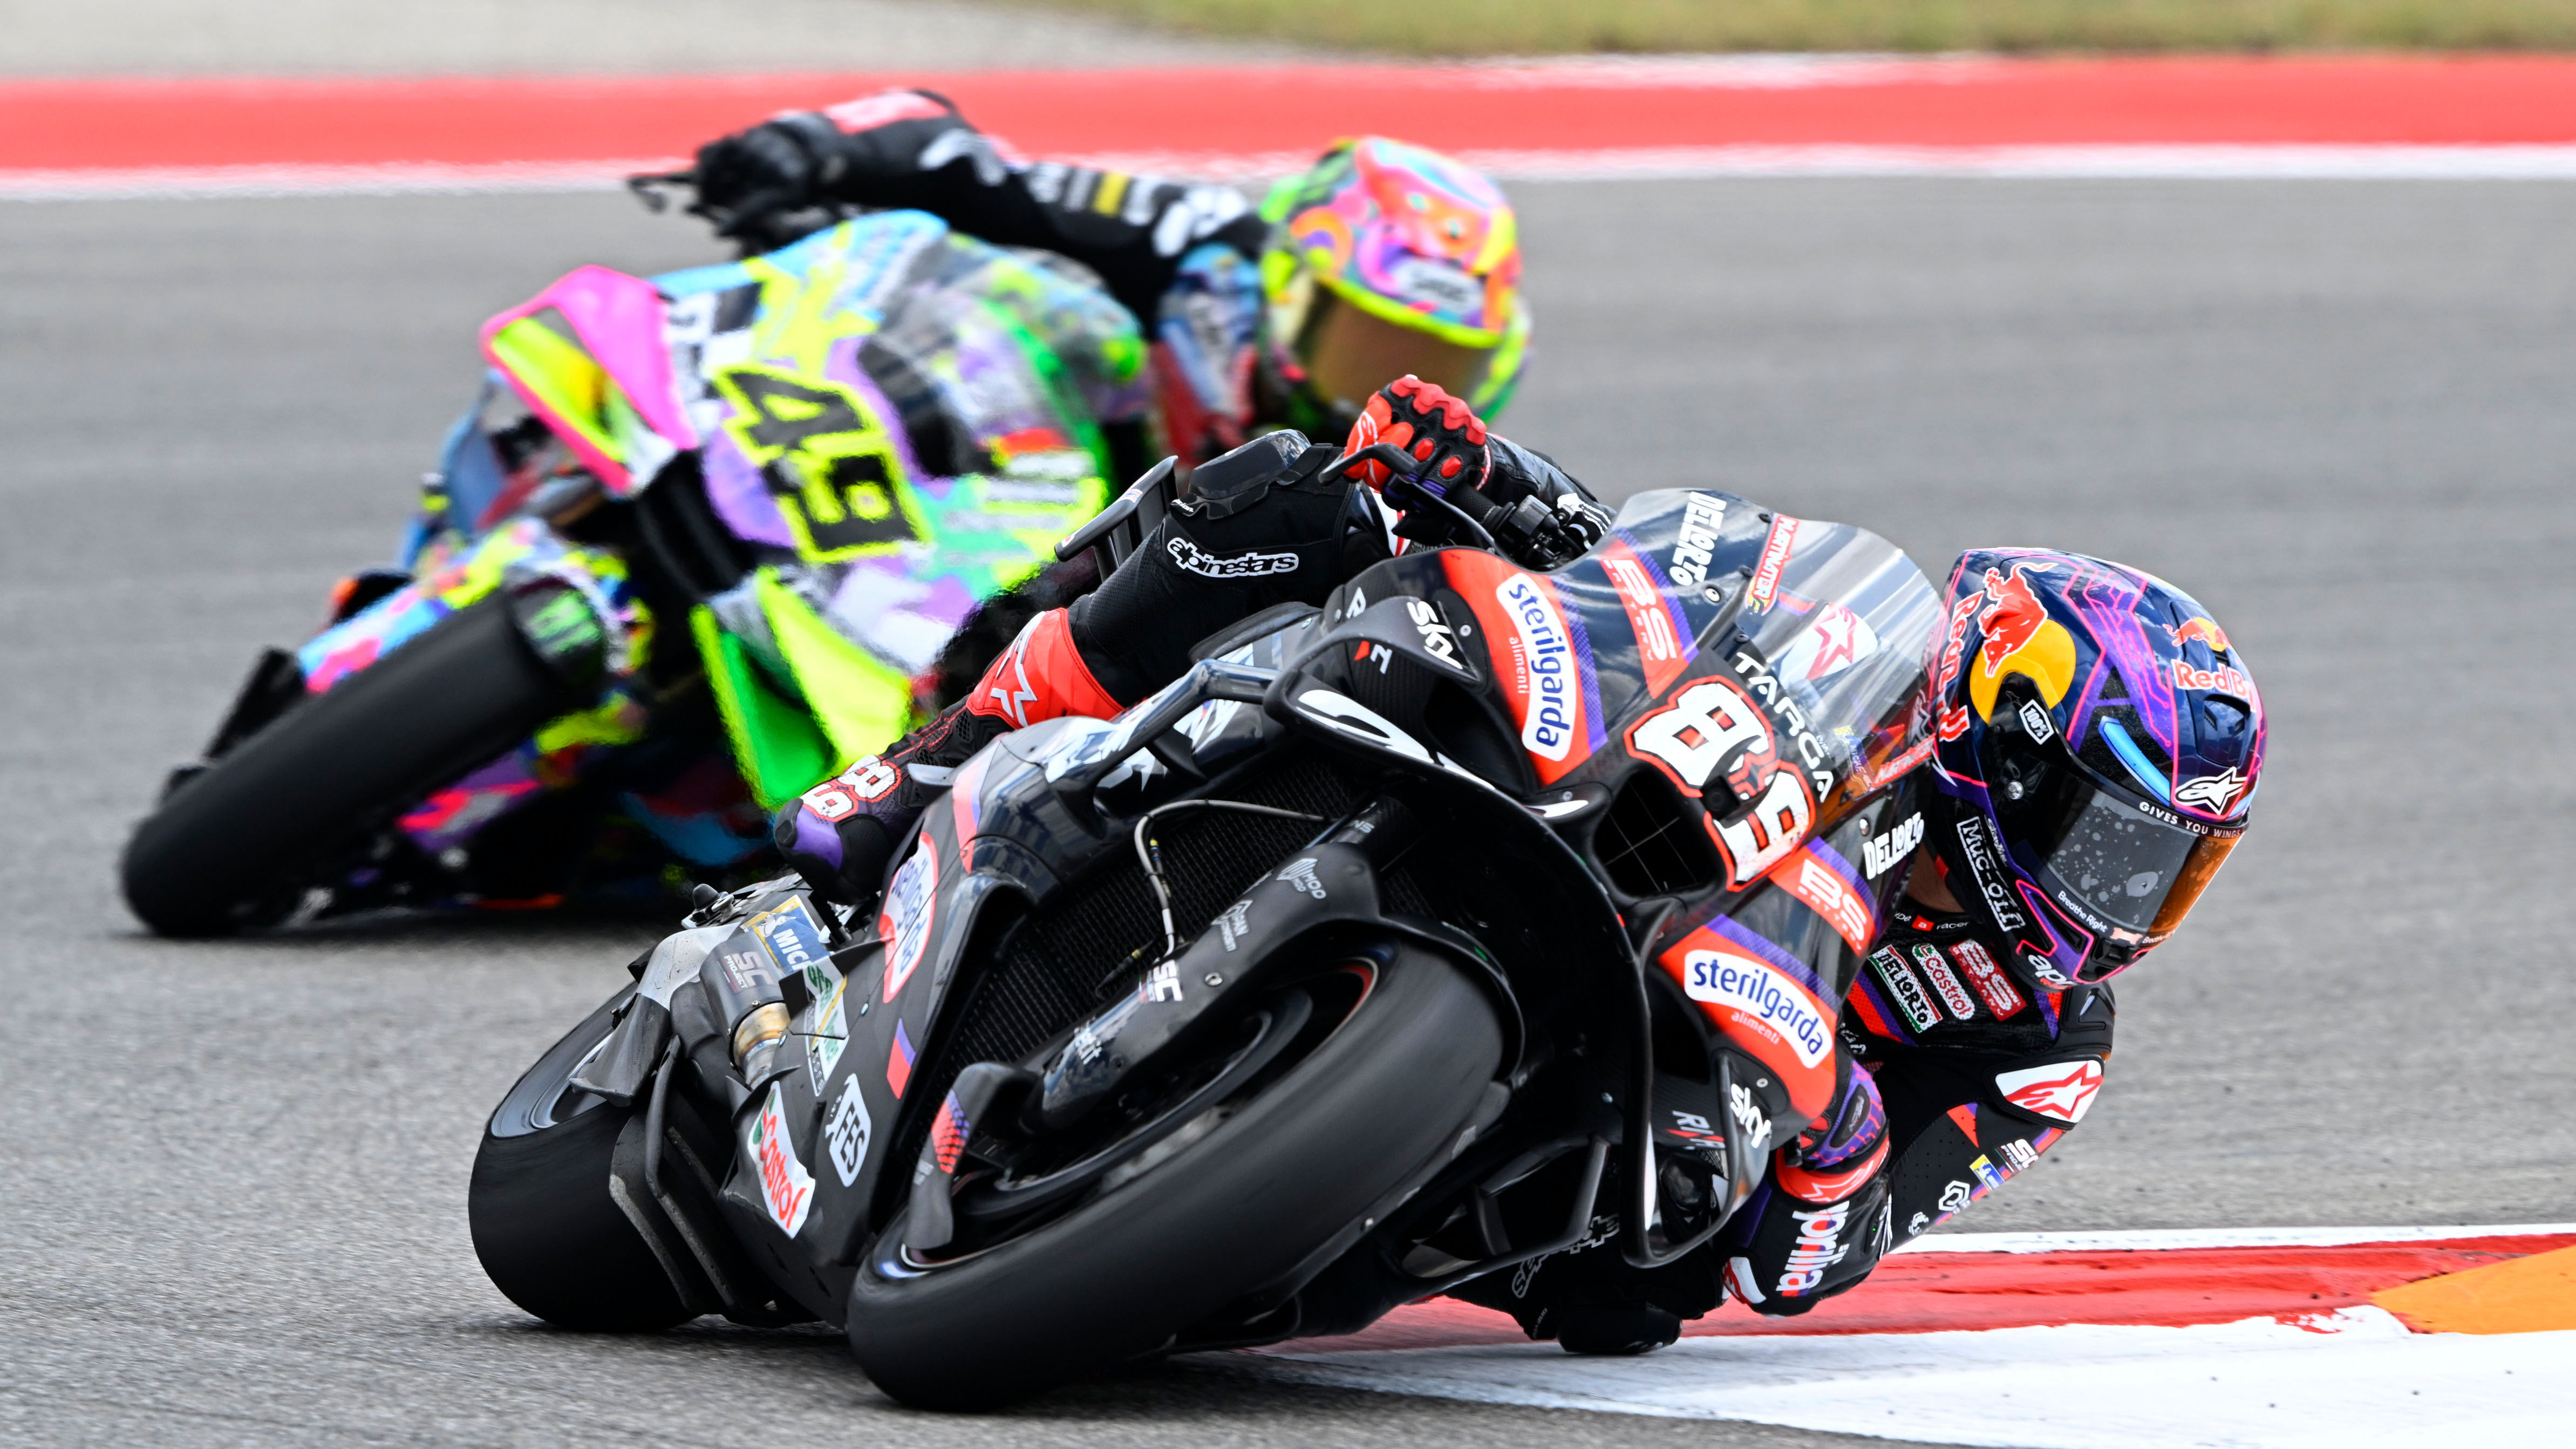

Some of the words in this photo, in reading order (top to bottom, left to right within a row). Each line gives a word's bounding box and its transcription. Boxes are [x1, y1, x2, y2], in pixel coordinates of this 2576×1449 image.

[1167, 537, 1299, 578] alpinestars
[1610, 560, 1677, 661] BS
[1509, 583, 1570, 748] sterilgarda
[1509, 637, 1529, 694] alimenti
[2171, 659, 2232, 693] Red
[2025, 708, 2048, 737] 100%
[1630, 678, 1813, 888] 89
[2139, 801, 2178, 825] GIVES
[2185, 820, 2209, 834] YOU
[2214, 828, 2240, 838] WINGS
[1800, 859, 1867, 941] BS
[2057, 890, 2087, 919] Breathe
[2086, 915, 2108, 933] Right
[1936, 921, 1970, 930] racer
[724, 955, 748, 988] PROJECT
[732, 951, 775, 987] SC
[1153, 960, 1183, 1002] SC
[1925, 957, 1973, 1015] Castrol
[1959, 940, 2019, 1011] BS
[1693, 958, 1823, 1055] sterilgarda
[1731, 1011, 1780, 1045] alimenti
[761, 1114, 807, 1229] Castrol
